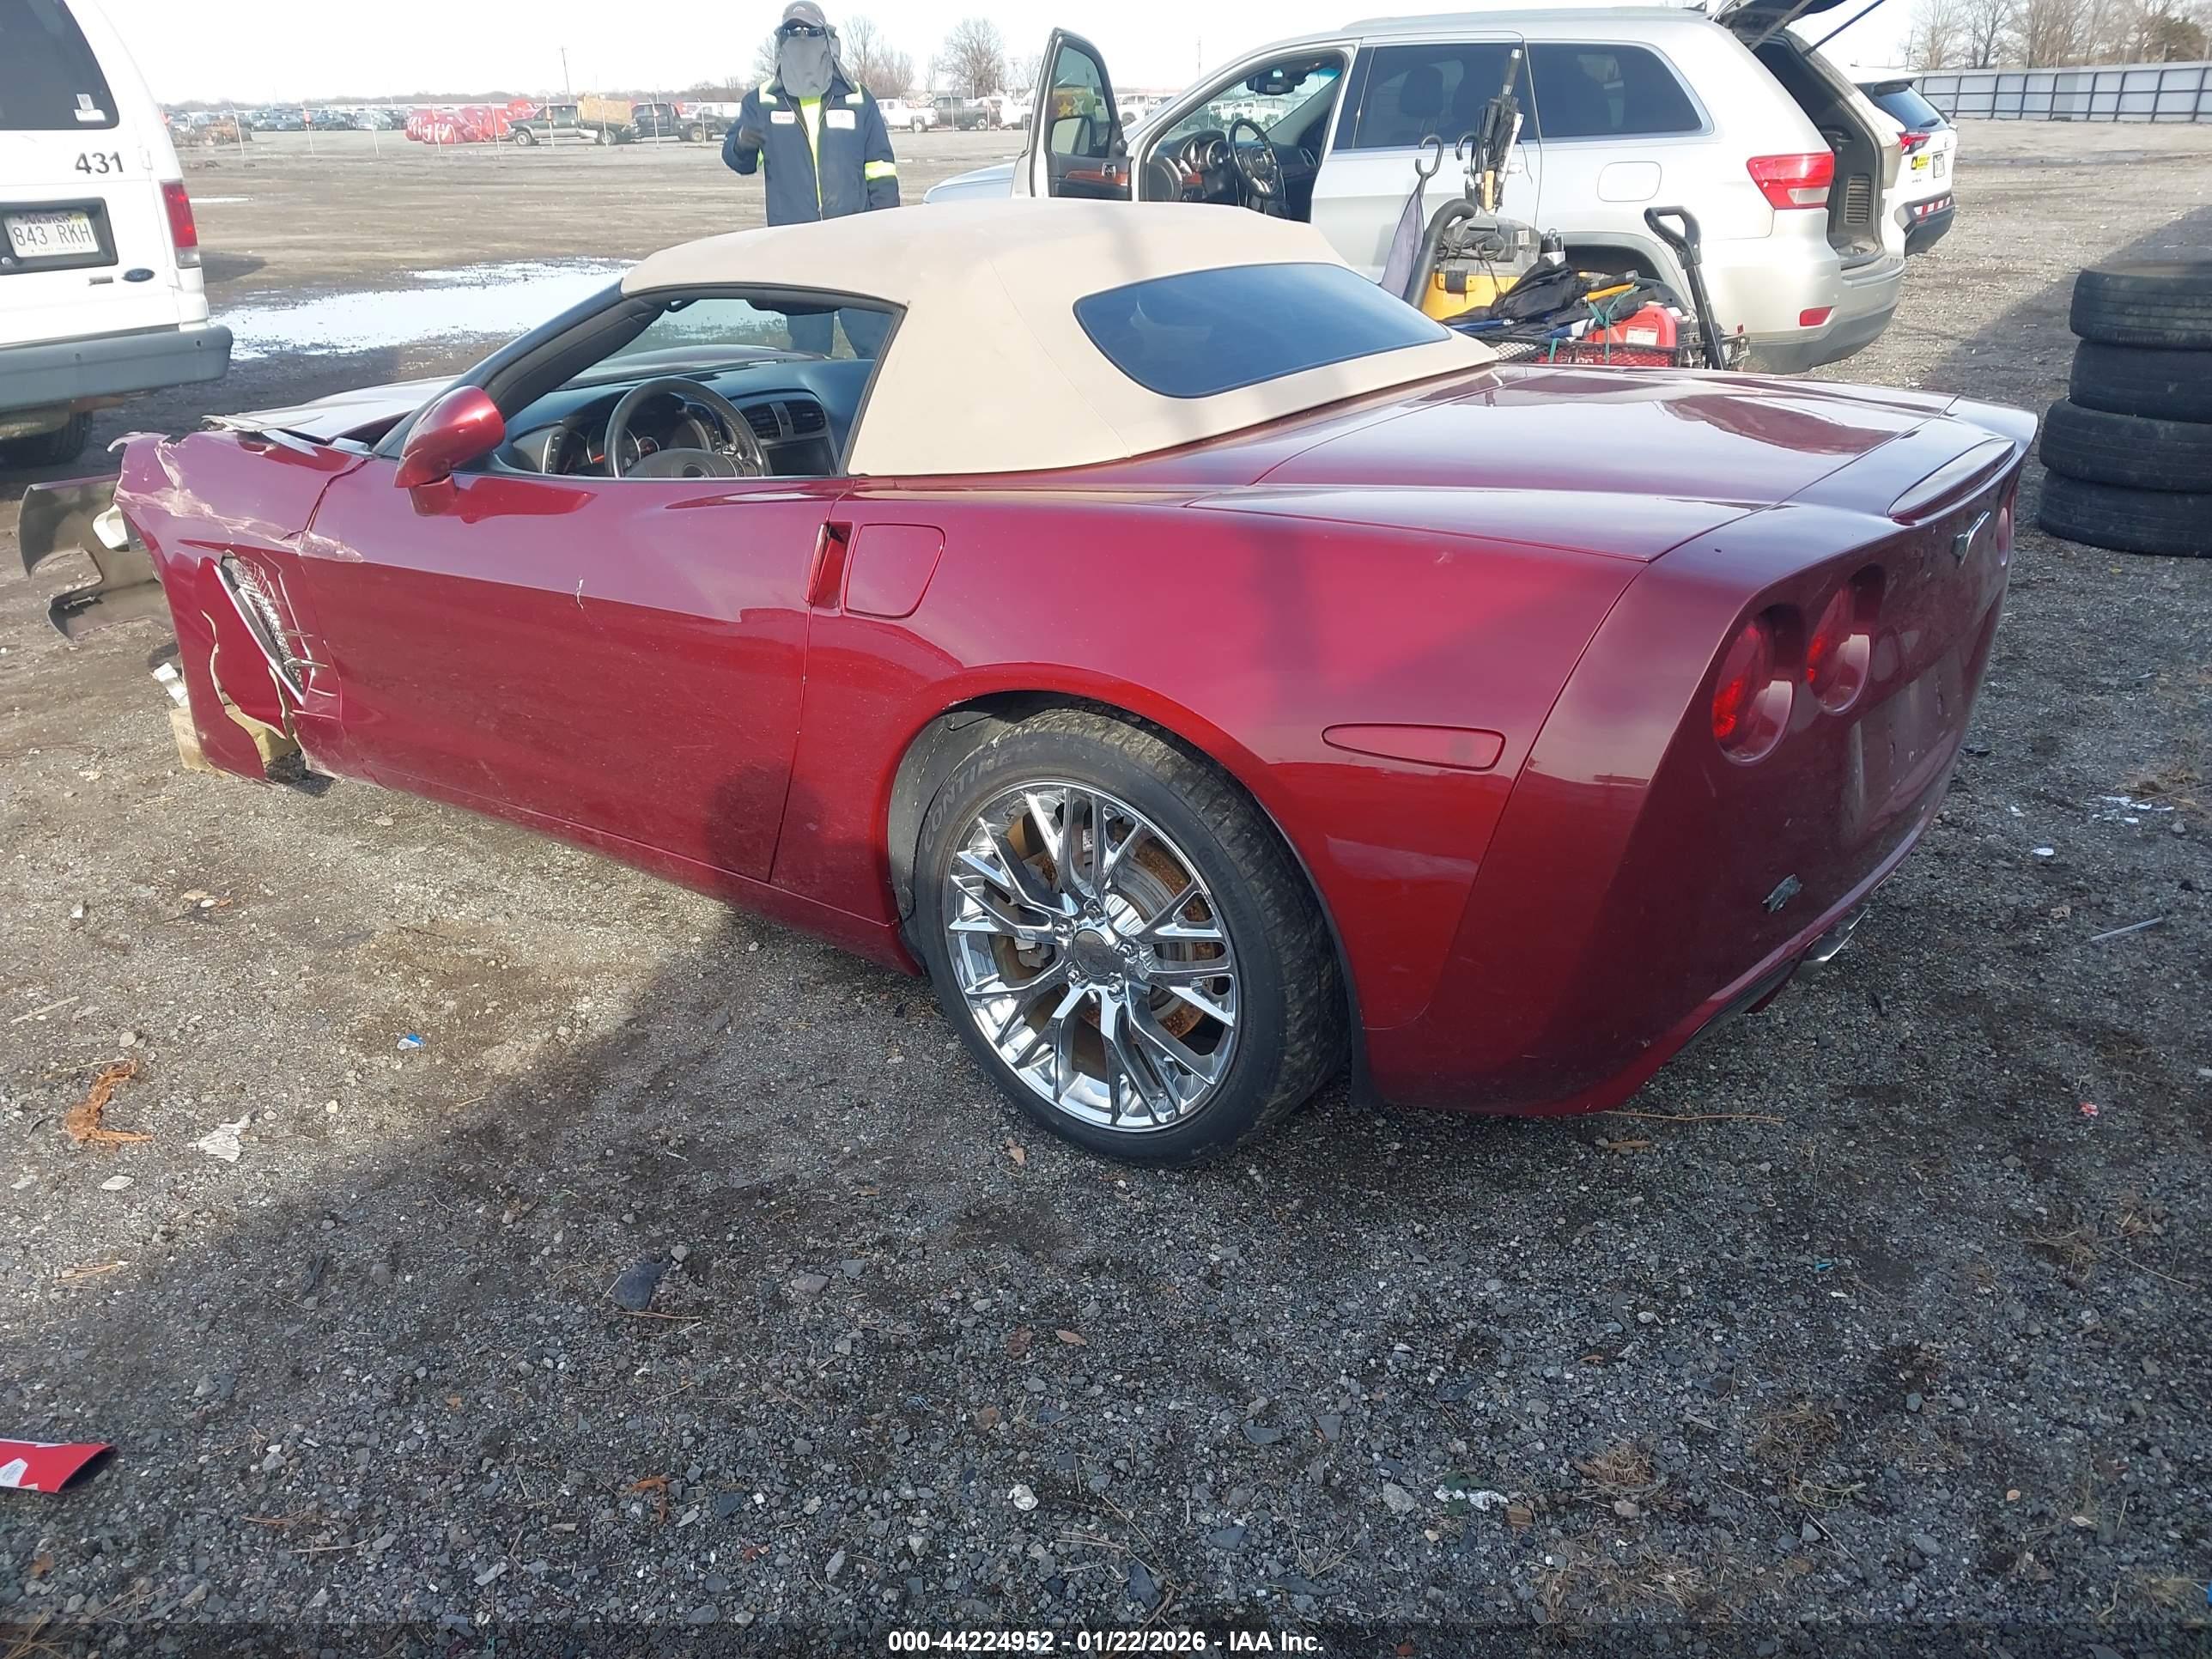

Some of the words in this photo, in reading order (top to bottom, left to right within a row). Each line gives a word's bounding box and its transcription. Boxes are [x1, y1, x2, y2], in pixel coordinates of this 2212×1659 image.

[75, 151, 124, 174] 431
[13, 226, 48, 246] 843
[56, 222, 93, 244] RKH
